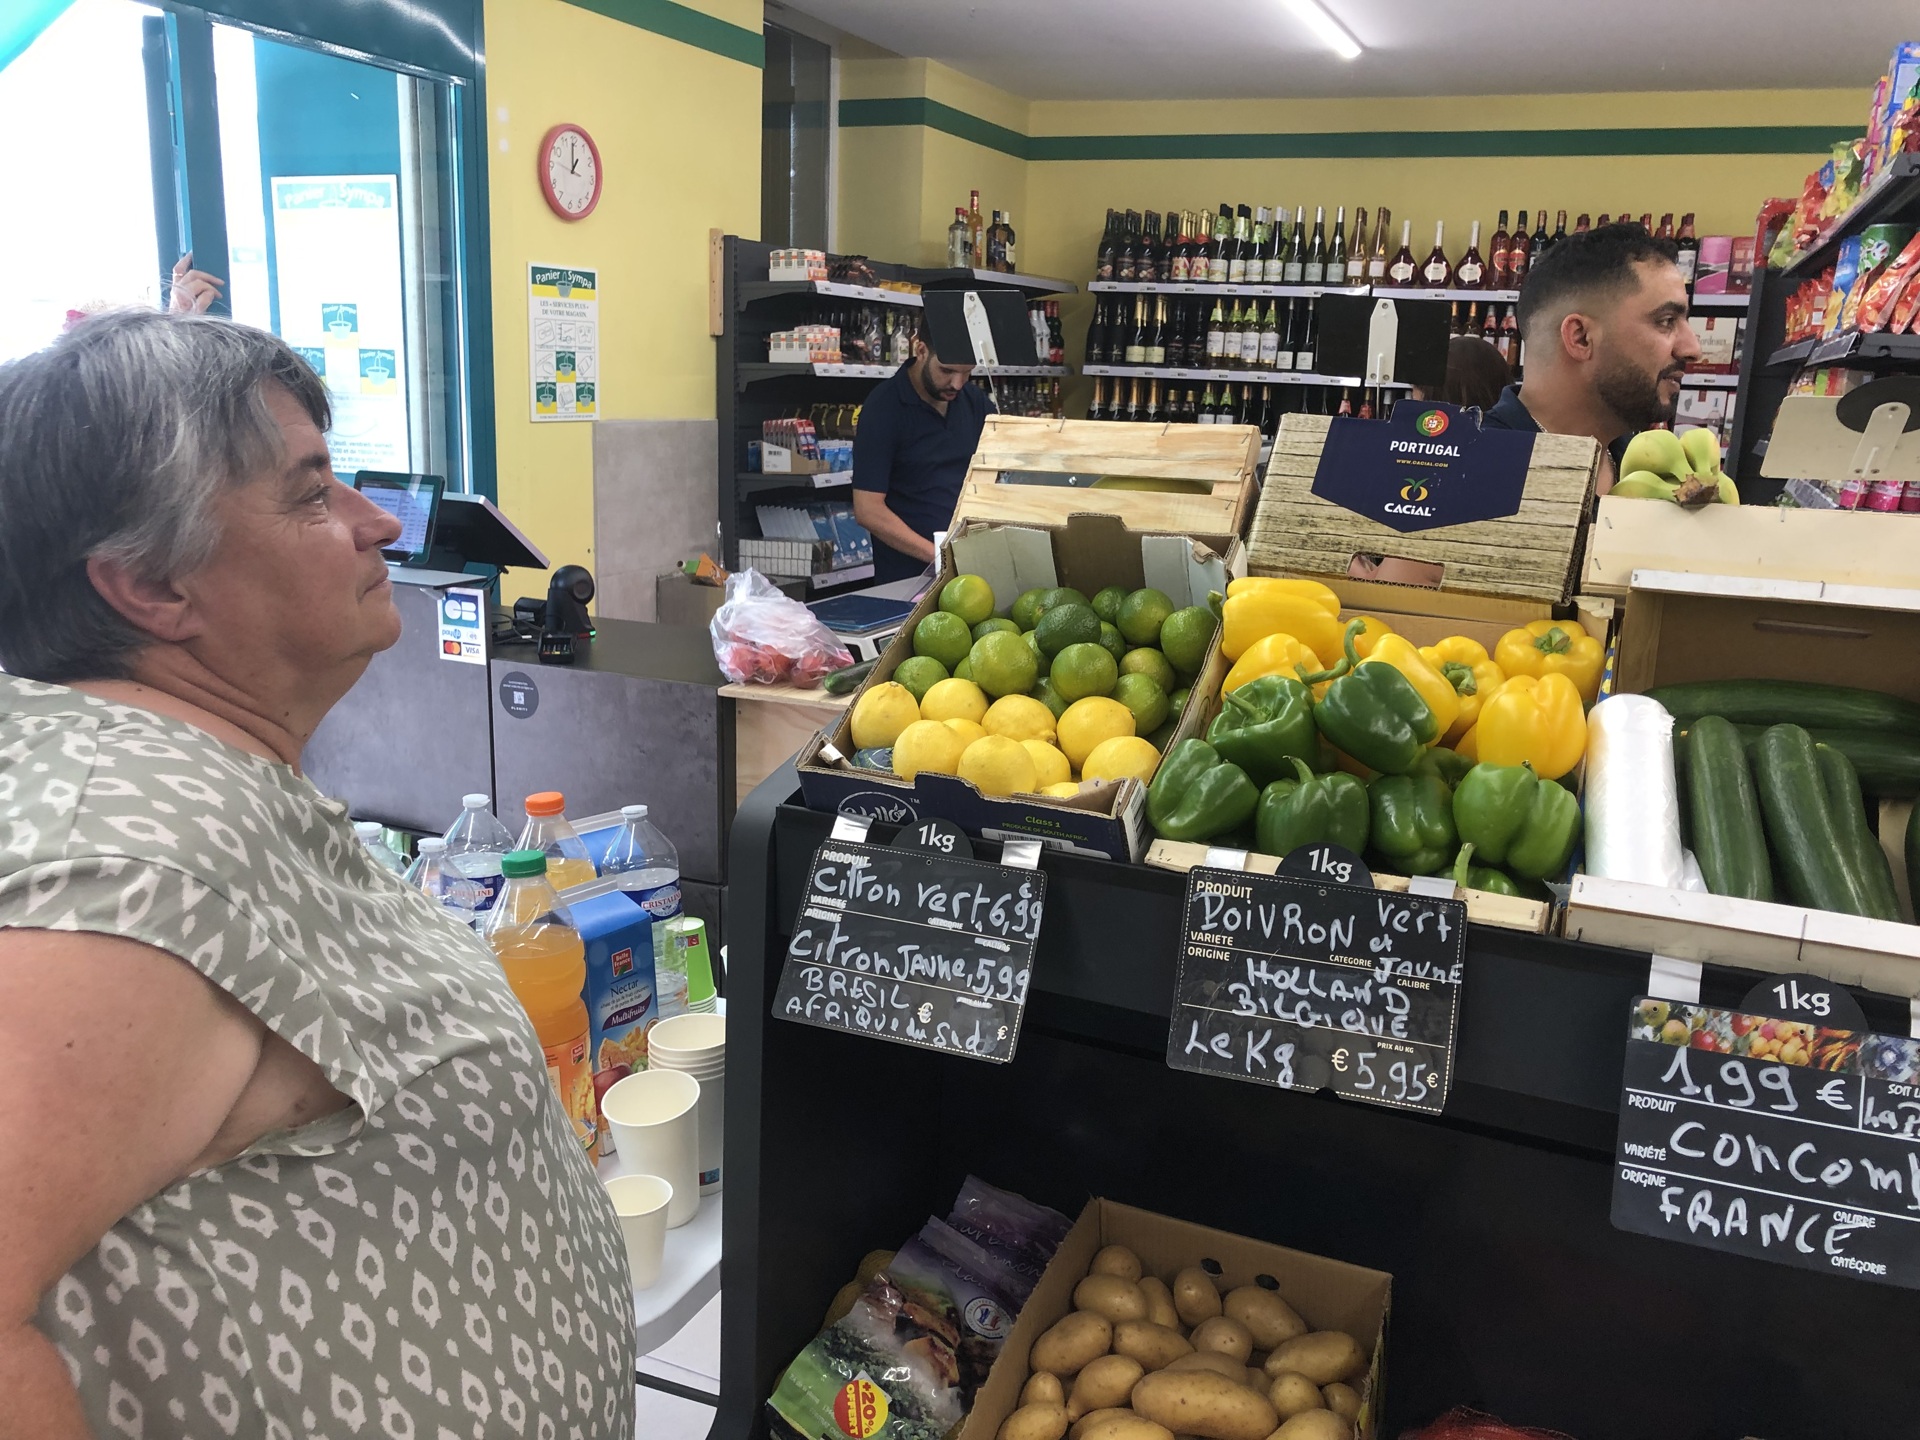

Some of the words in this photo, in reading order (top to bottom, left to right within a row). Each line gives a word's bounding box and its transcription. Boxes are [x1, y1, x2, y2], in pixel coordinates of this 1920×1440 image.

[536, 270, 560, 284] Panier
[568, 270, 592, 289] Sympa
[1390, 440, 1460, 457] PORTUGAL
[1396, 459, 1448, 468] WWW.CACIAL.COM
[466, 646, 480, 654] VISA
[1025, 816, 1052, 827] Class
[918, 823, 956, 852] 1kg
[1002, 822, 1032, 832] PRODUCE
[1042, 828, 1065, 837] SOUTH
[1065, 833, 1088, 842] AFRICA
[1309, 848, 1352, 883] 1kg
[814, 864, 900, 907] Citron
[1196, 880, 1253, 899] PRODUIT
[804, 908, 842, 922] ORIGINE
[1190, 930, 1234, 946] VARIETE
[790, 925, 890, 973] Citron
[1188, 946, 1230, 962] ORIGINE
[1329, 954, 1372, 968] CATEGORIE
[610, 980, 638, 997] Nectar
[800, 967, 909, 1010] BRESIL
[1396, 978, 1430, 990] CALIBRE
[1772, 980, 1831, 1017] 1kg
[611, 1006, 646, 1026] Multifruits
[918, 1002, 934, 1024] €
[996, 1025, 1008, 1040] €
[1376, 1041, 1393, 1051] PRIX
[1393, 1044, 1404, 1052] AU
[1405, 1045, 1414, 1054] KG
[1332, 1048, 1349, 1072] €
[1354, 1052, 1428, 1102] 5,95
[1426, 1072, 1438, 1088] €
[1660, 1046, 1799, 1112] 1,99
[1816, 1078, 1852, 1110] €
[1888, 1083, 1912, 1097] SOIT
[1628, 1094, 1676, 1114] PRODUIT
[1624, 1142, 1667, 1161] VARIÉTÉ
[1621, 1168, 1667, 1187] ORIGINE
[1659, 1187, 1866, 1255] FRANCE
[1833, 1210, 1876, 1228] CALIBRE
[1831, 1256, 1887, 1275] CATÉGORIE
[846, 1384, 859, 1436] OFFERT
[862, 1382, 877, 1434] +20%
